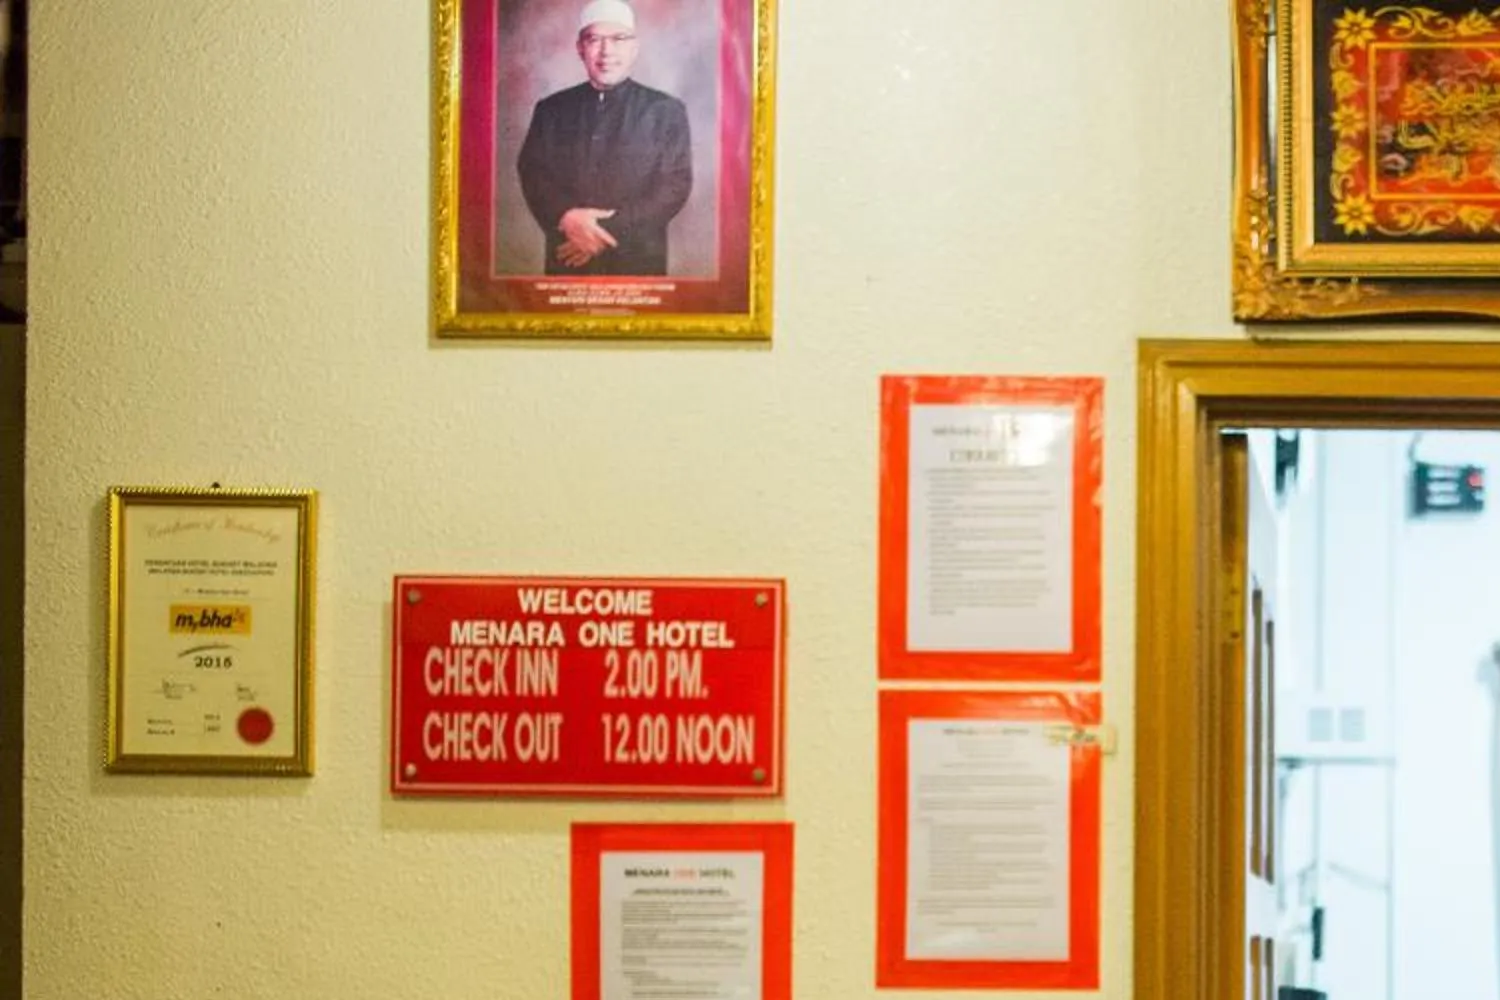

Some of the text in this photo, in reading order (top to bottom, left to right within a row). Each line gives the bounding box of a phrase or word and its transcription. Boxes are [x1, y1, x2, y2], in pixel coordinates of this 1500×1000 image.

[518, 588, 653, 615] WELCOME
[450, 621, 734, 648] MENARA ONE HOTEL
[424, 647, 709, 698] CHECK INN 2.00 PM.
[423, 712, 755, 763] CHECK OUT 12.00 NOON
